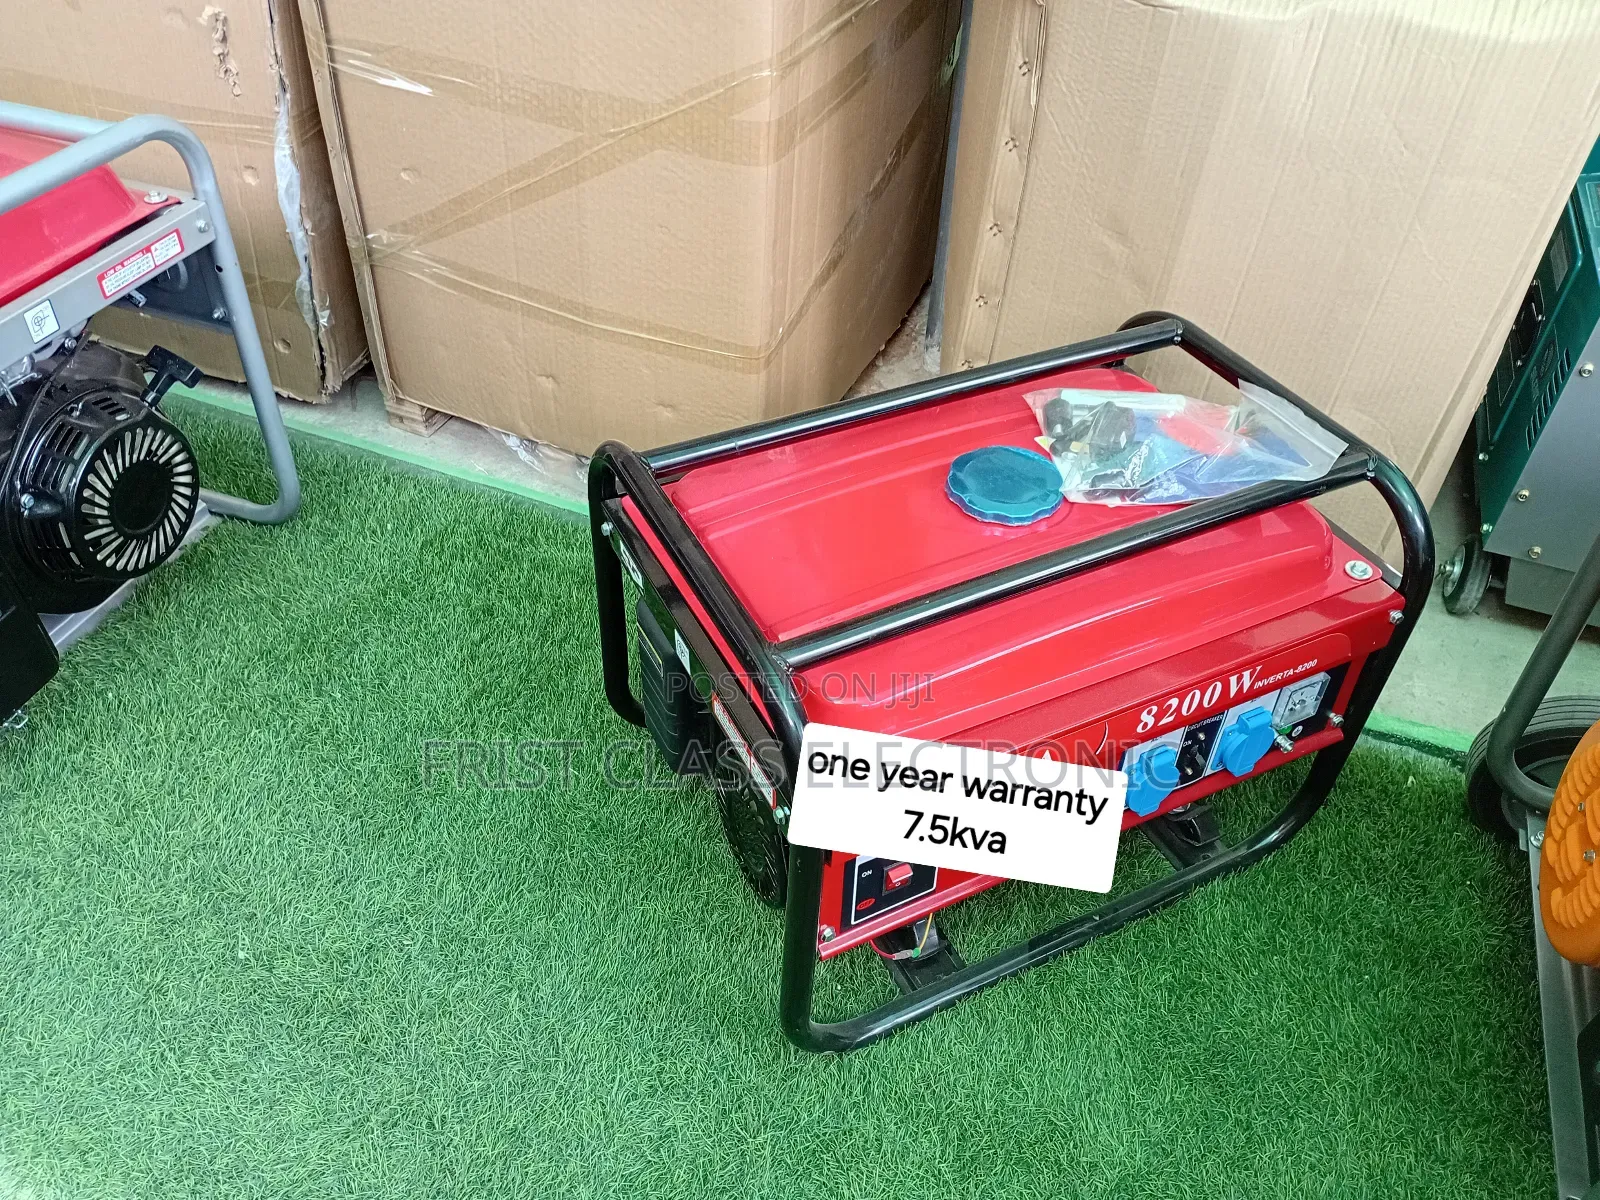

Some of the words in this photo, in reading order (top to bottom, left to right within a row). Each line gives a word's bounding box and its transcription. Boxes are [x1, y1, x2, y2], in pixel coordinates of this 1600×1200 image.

[104, 269, 115, 278] LOW
[1253, 658, 1318, 690] INVERTA-8200
[1202, 714, 1224, 726] BREAKER
[861, 869, 873, 878] ON
